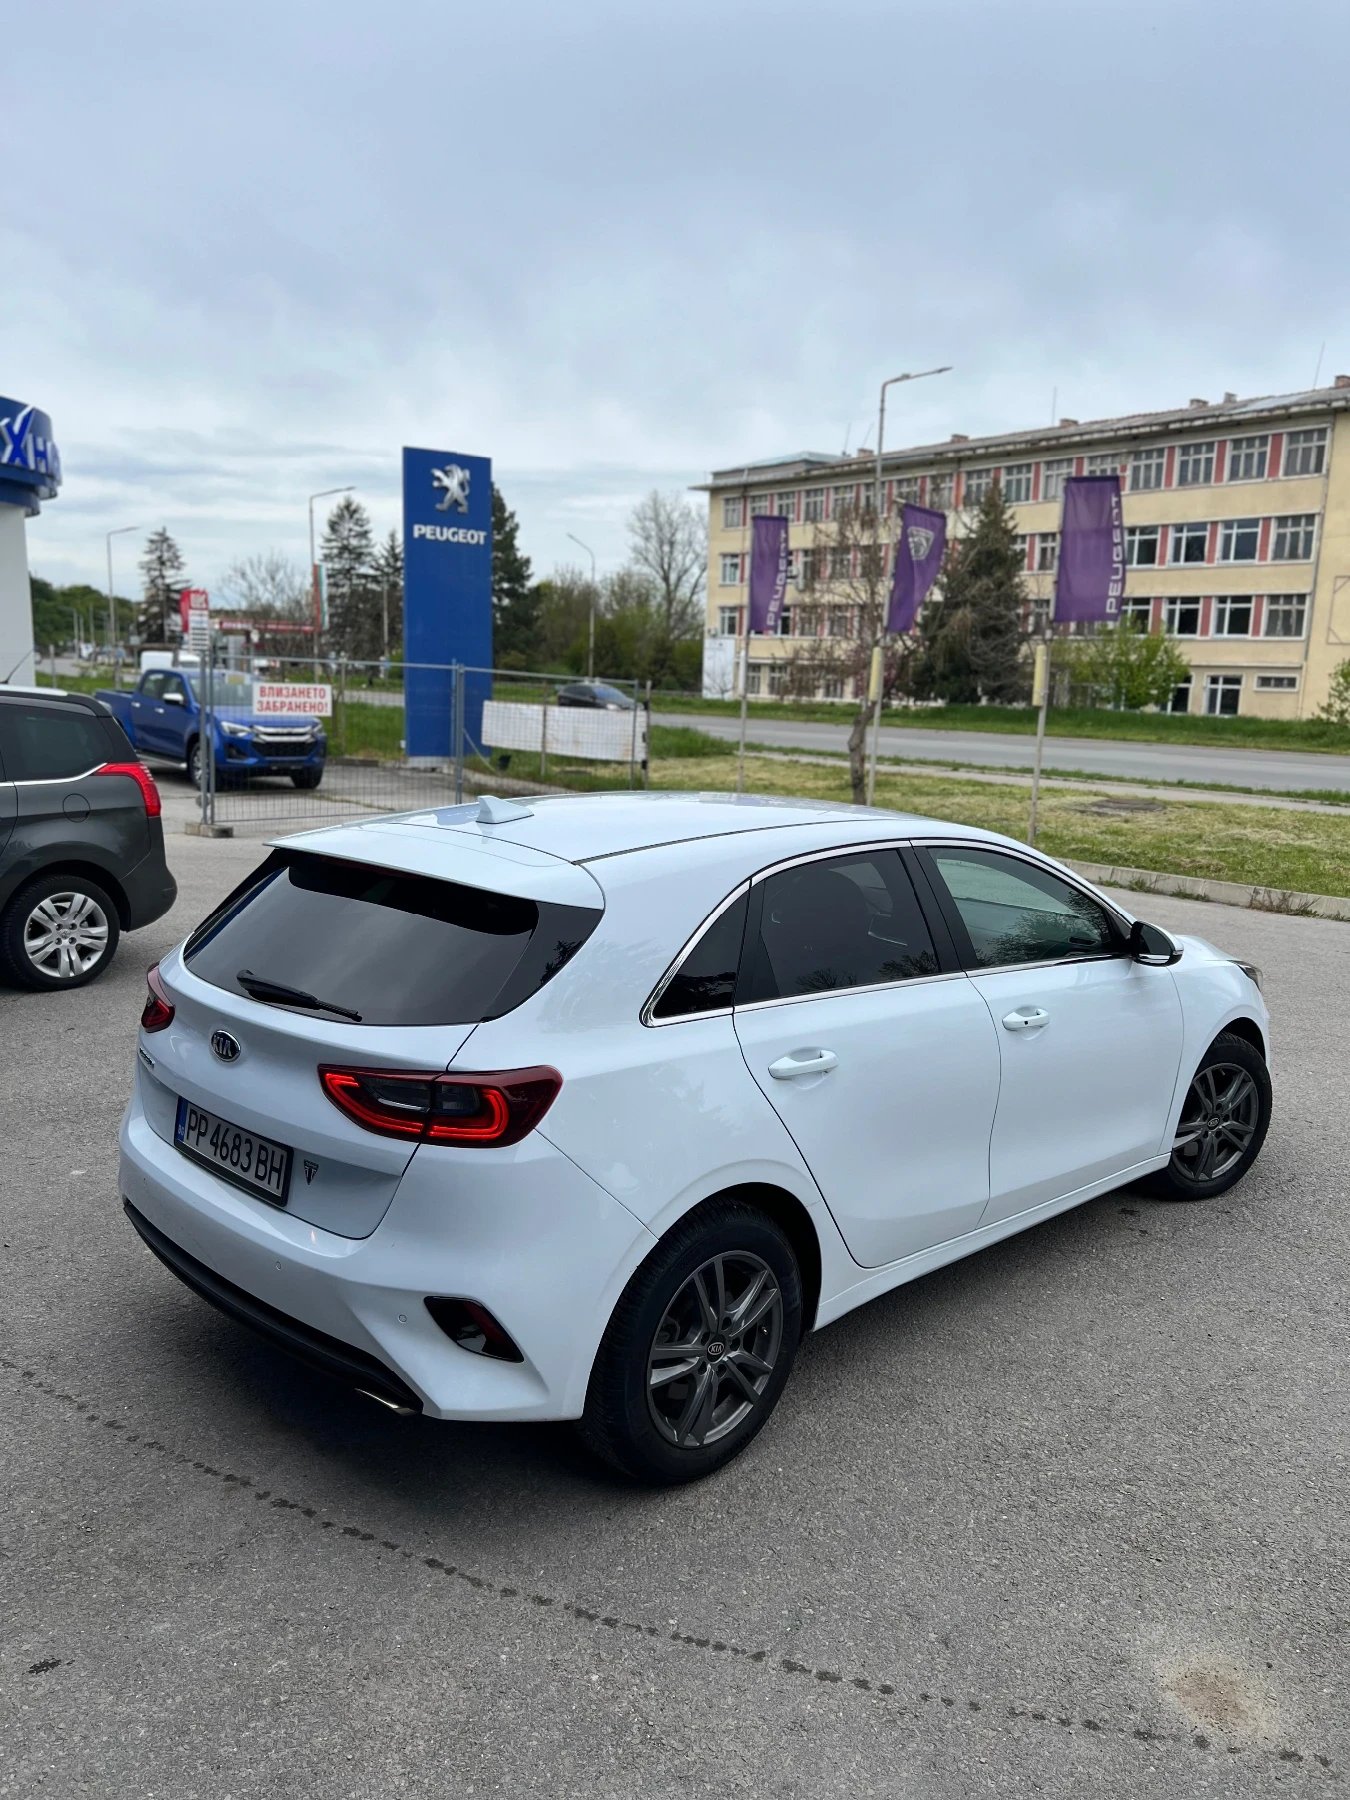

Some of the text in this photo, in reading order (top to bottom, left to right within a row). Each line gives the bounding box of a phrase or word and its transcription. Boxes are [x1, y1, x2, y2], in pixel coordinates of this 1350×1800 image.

[413, 524, 487, 545] PEUGEOT
[259, 686, 326, 699] ВЛИЗАНЕТО
[257, 701, 328, 713] ЗАБРАНЕНО!
[212, 1034, 233, 1057] KIA
[186, 1109, 284, 1190] PP 4683 BH
[710, 1345, 722, 1353] KIA
